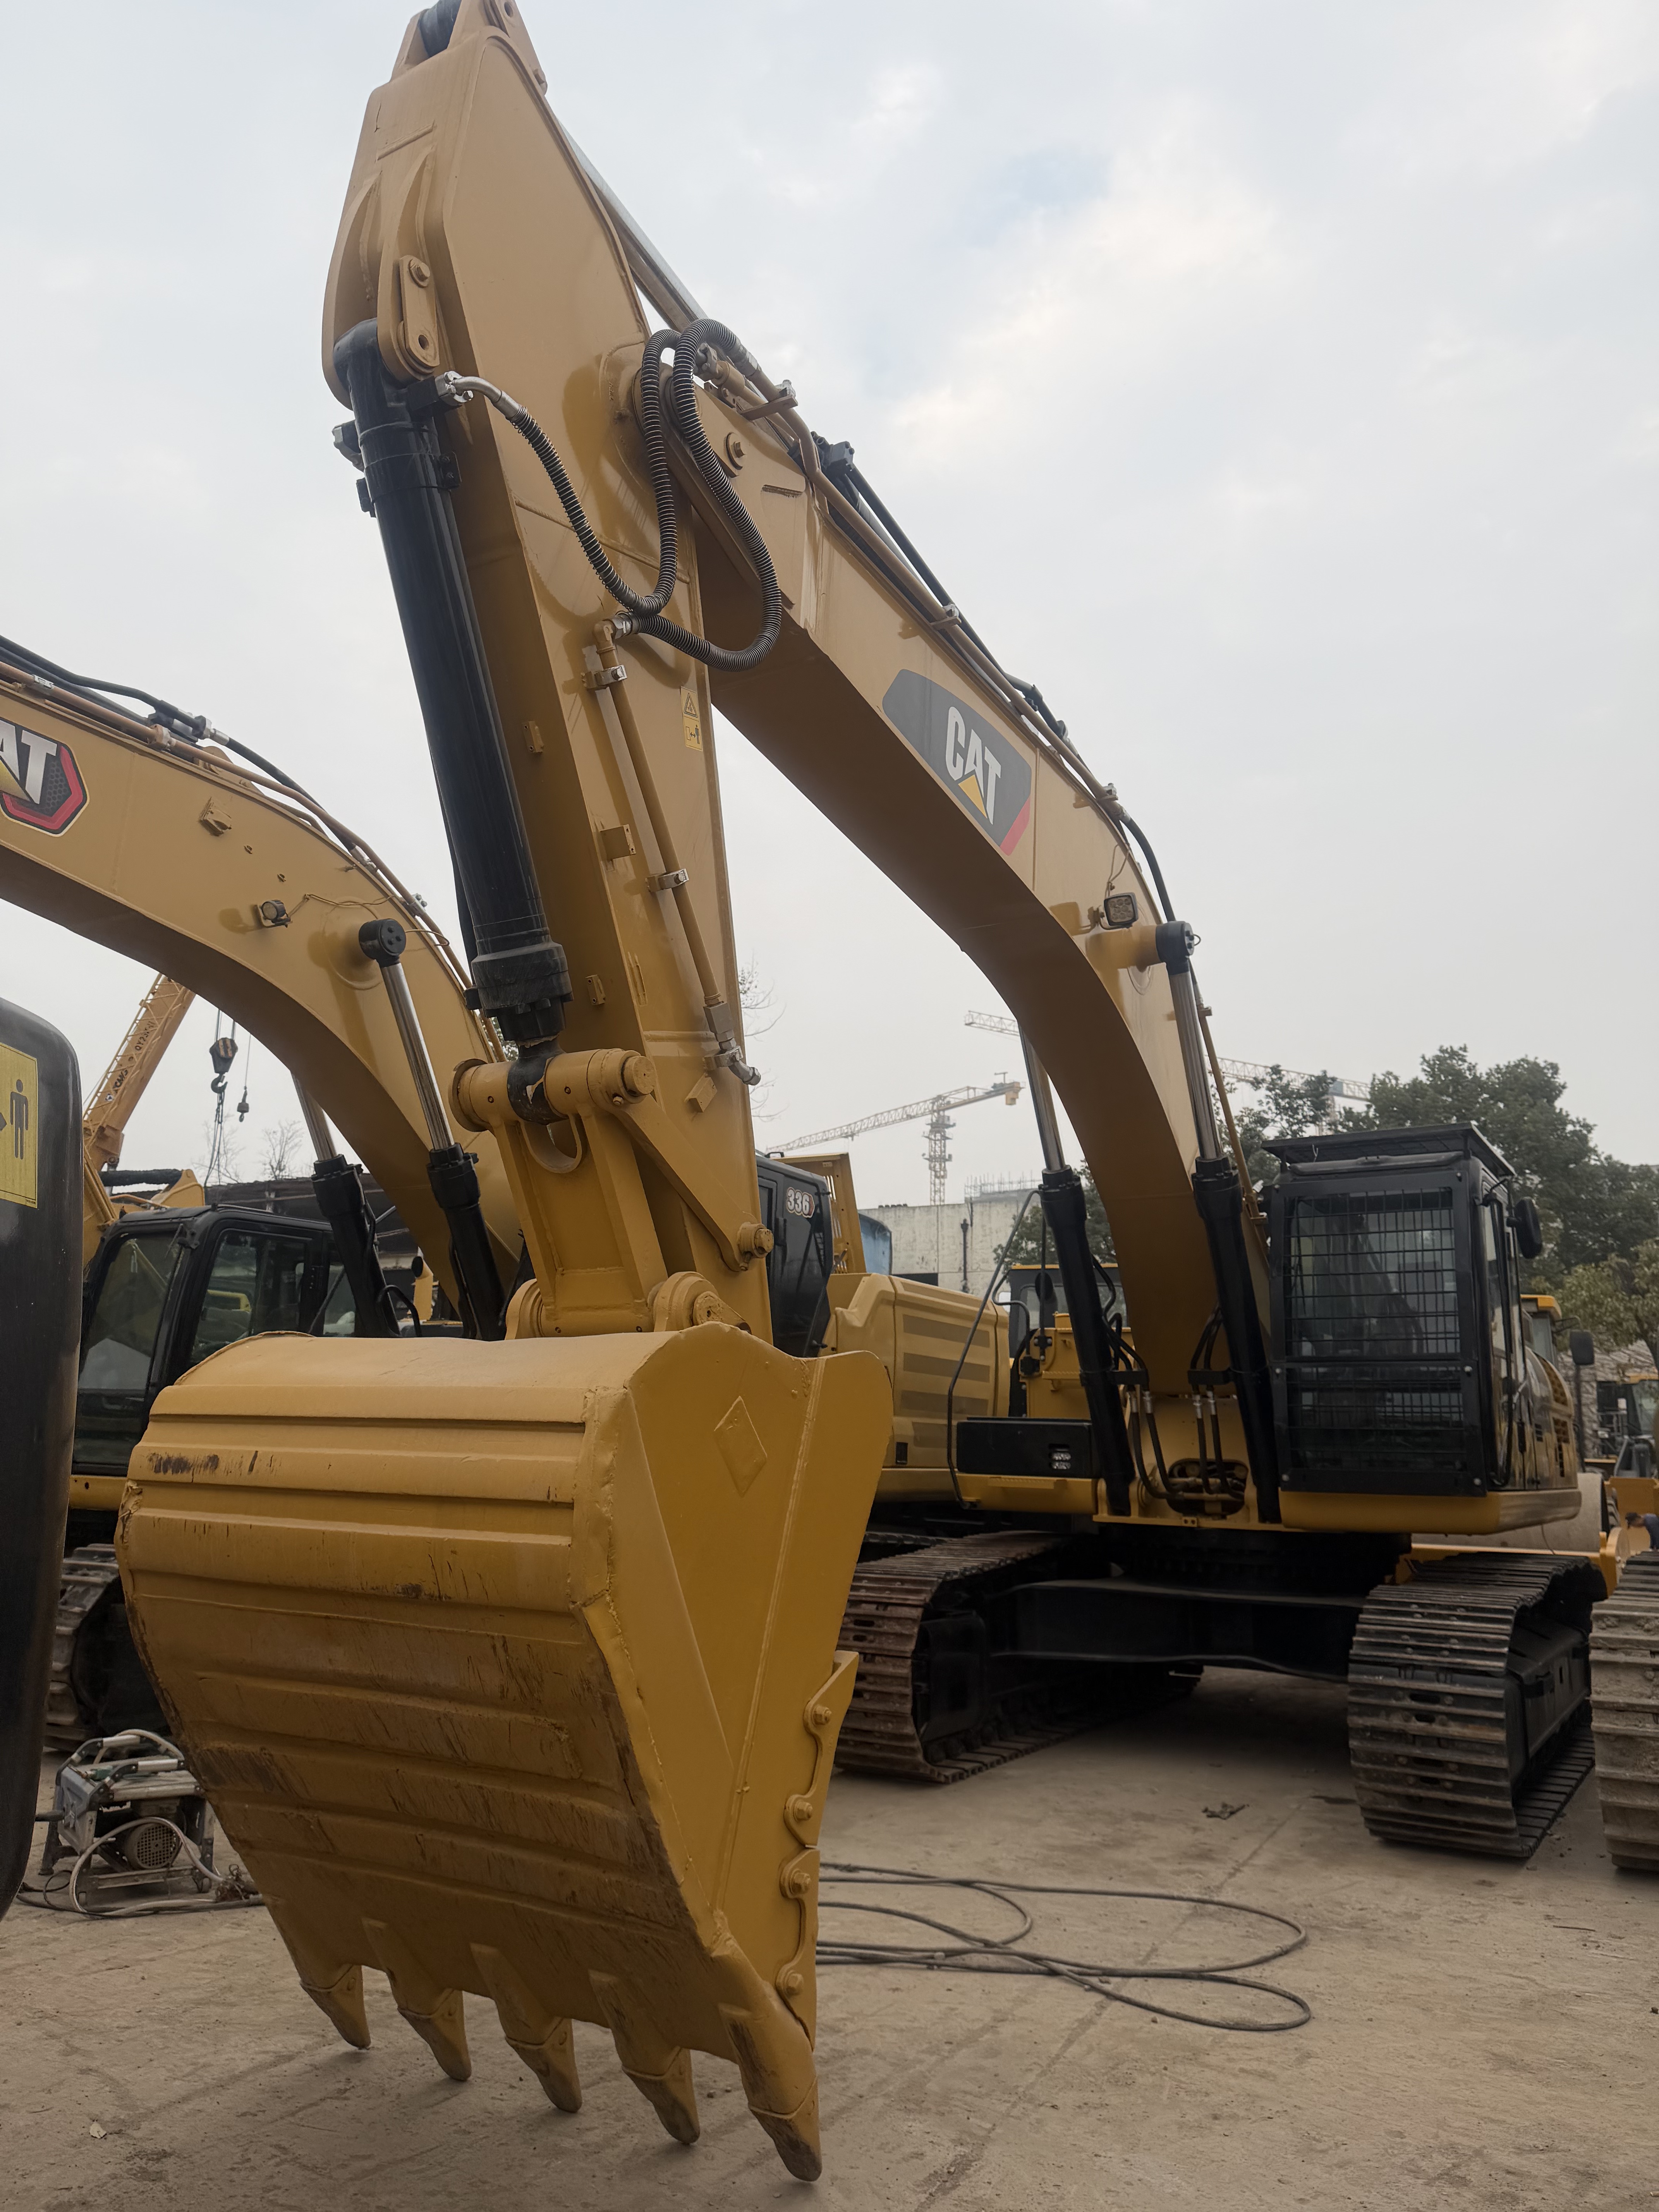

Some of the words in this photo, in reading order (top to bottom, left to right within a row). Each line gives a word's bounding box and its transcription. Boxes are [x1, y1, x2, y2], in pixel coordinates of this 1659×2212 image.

[0, 719, 57, 804] AT
[946, 706, 1001, 824] CAT
[787, 1188, 810, 1216] 336
